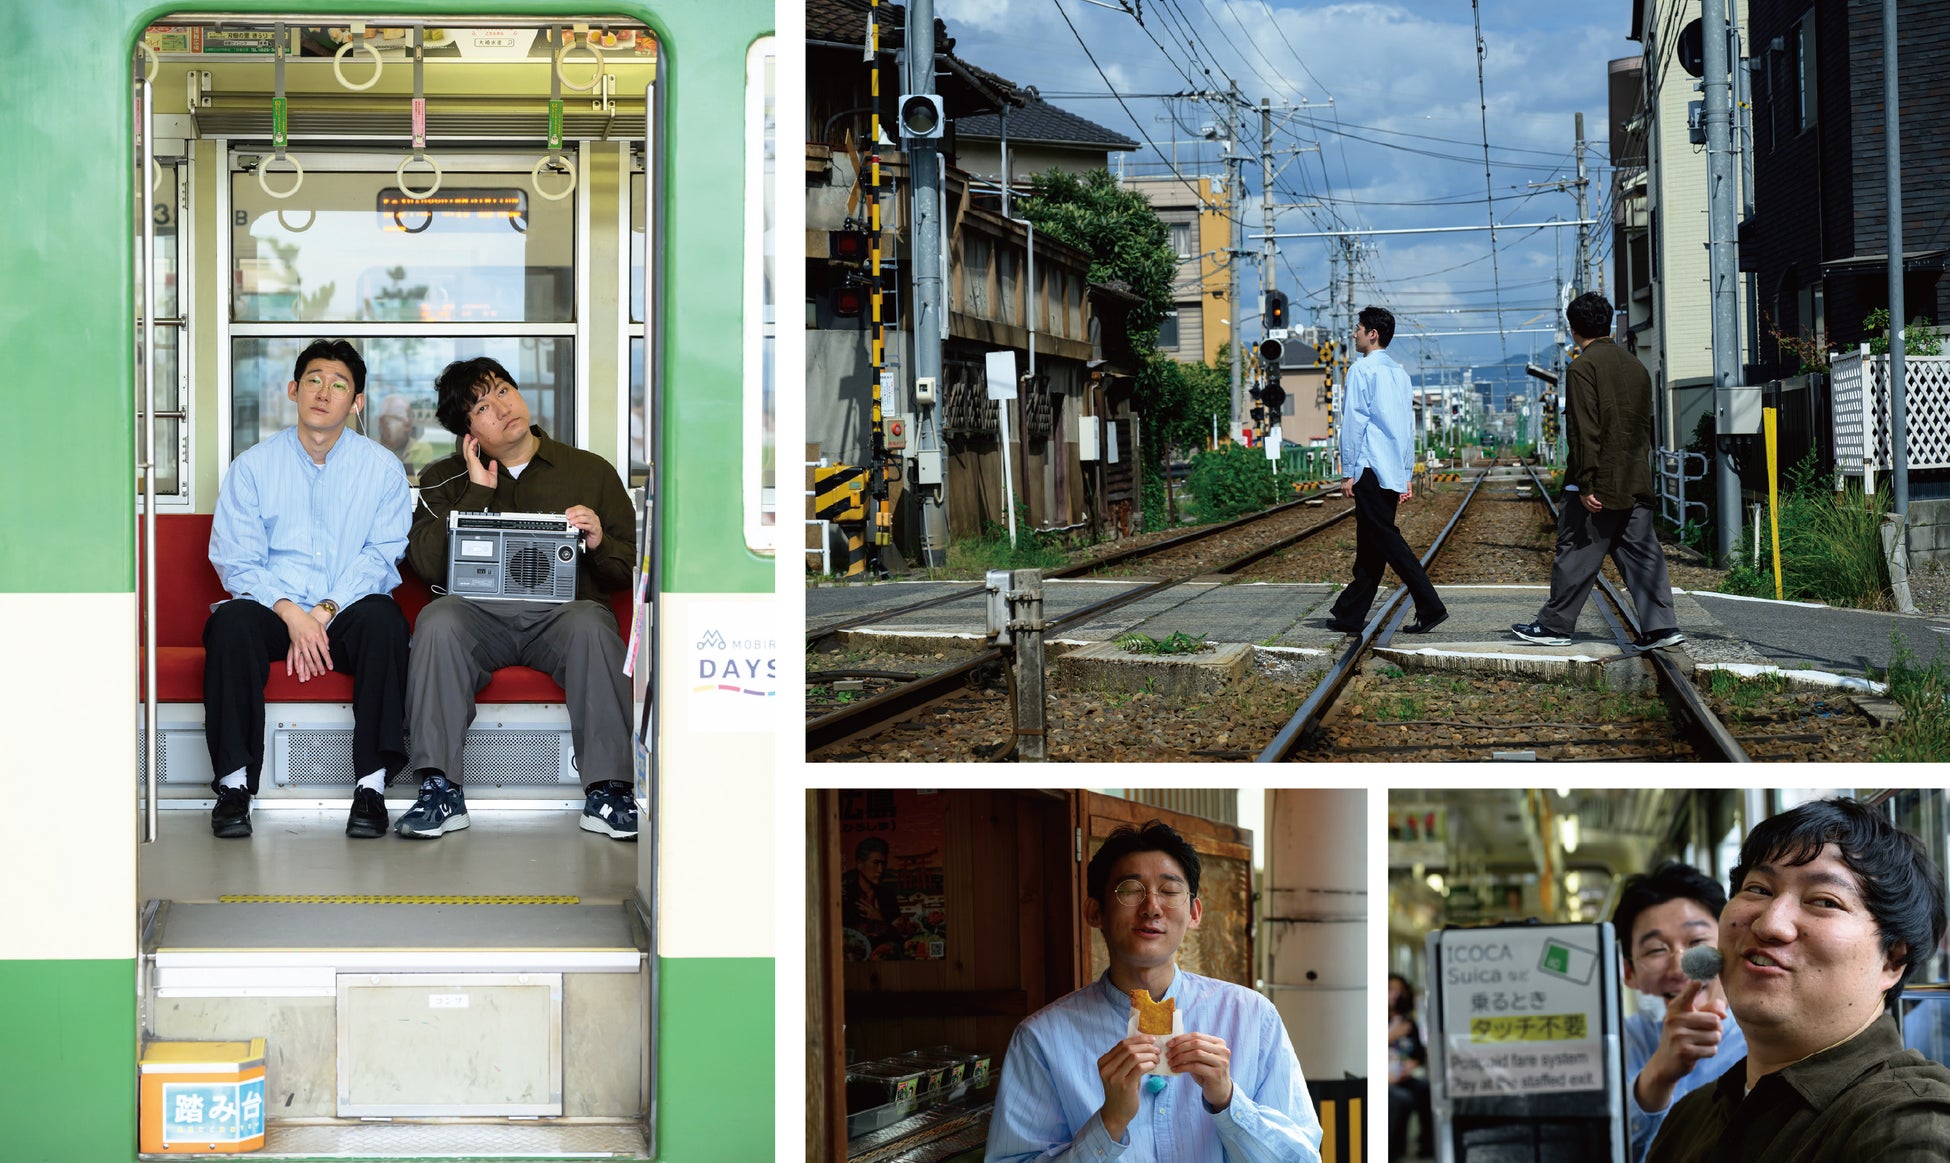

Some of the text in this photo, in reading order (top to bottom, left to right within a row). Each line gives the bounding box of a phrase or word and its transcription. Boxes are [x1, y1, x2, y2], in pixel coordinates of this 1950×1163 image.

[699, 658, 776, 679] DAYS
[1447, 944, 1513, 963] ICOCA
[1447, 967, 1502, 985] Suica
[1472, 991, 1547, 1013] 乗るとき
[1472, 1017, 1586, 1042] タッチ不要
[1512, 1053, 1537, 1067] fare
[1541, 1053, 1588, 1069] system
[1521, 1073, 1566, 1088] staffed
[174, 1091, 262, 1123] 踏み台
